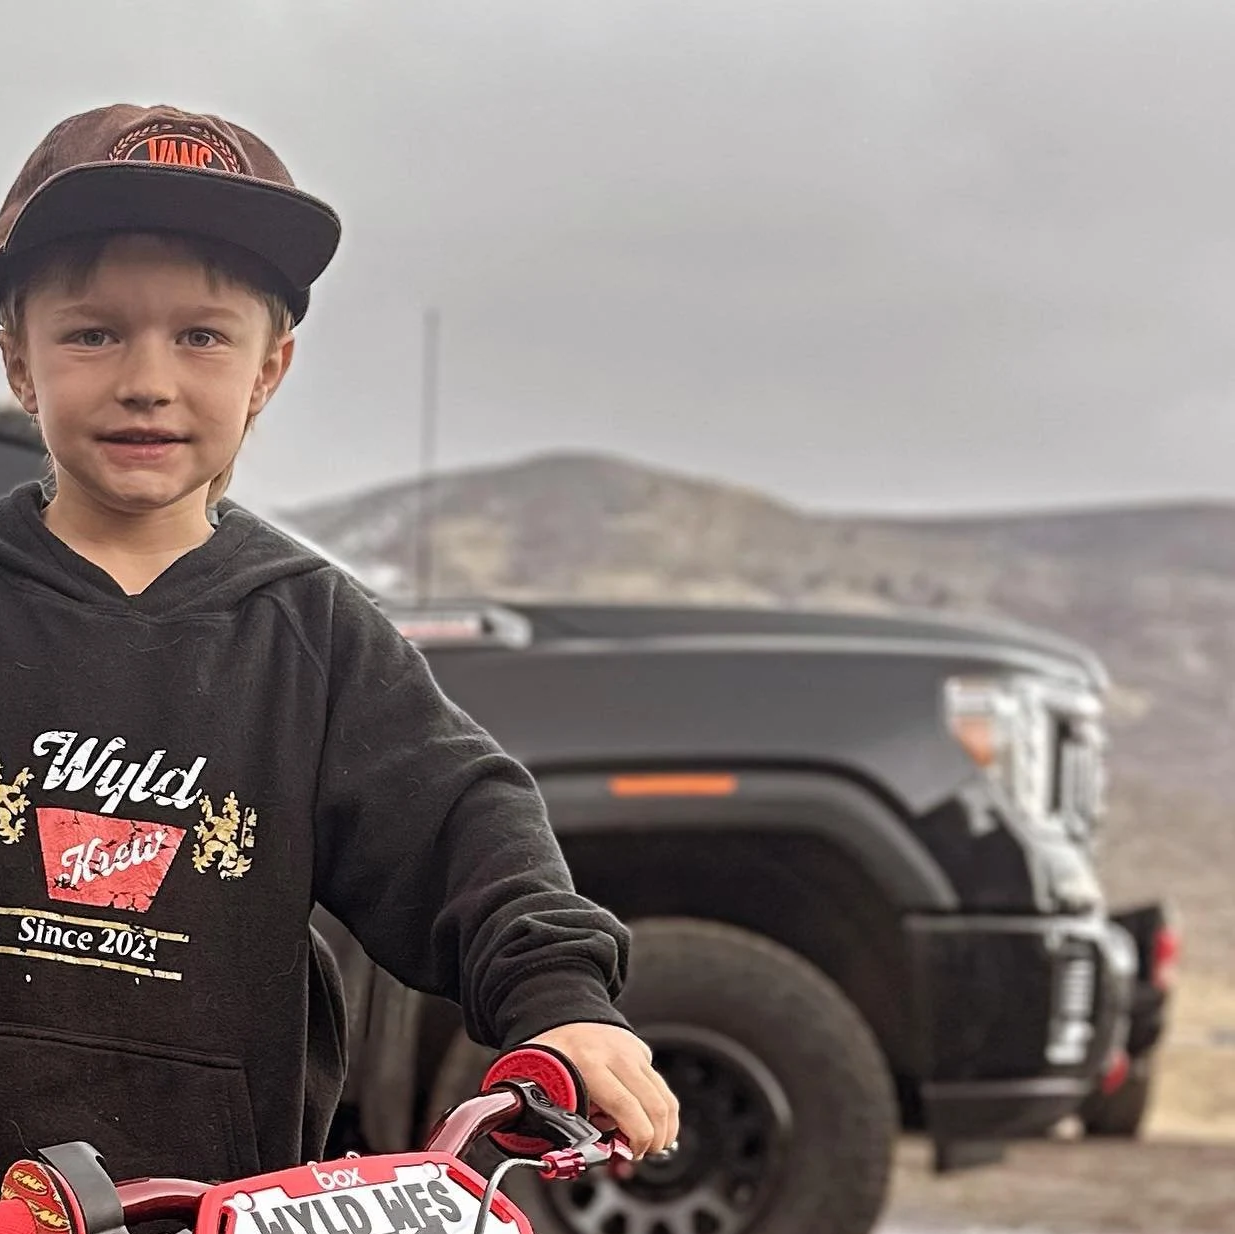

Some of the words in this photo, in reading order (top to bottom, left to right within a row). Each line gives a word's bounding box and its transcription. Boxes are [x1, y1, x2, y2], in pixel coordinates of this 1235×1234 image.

[147, 137, 213, 169] VANS
[33, 731, 206, 813] Wyld
[58, 831, 168, 887] Krew
[18, 916, 93, 951] Since
[311, 1166, 366, 1191] box
[372, 1180, 462, 1234] WES
